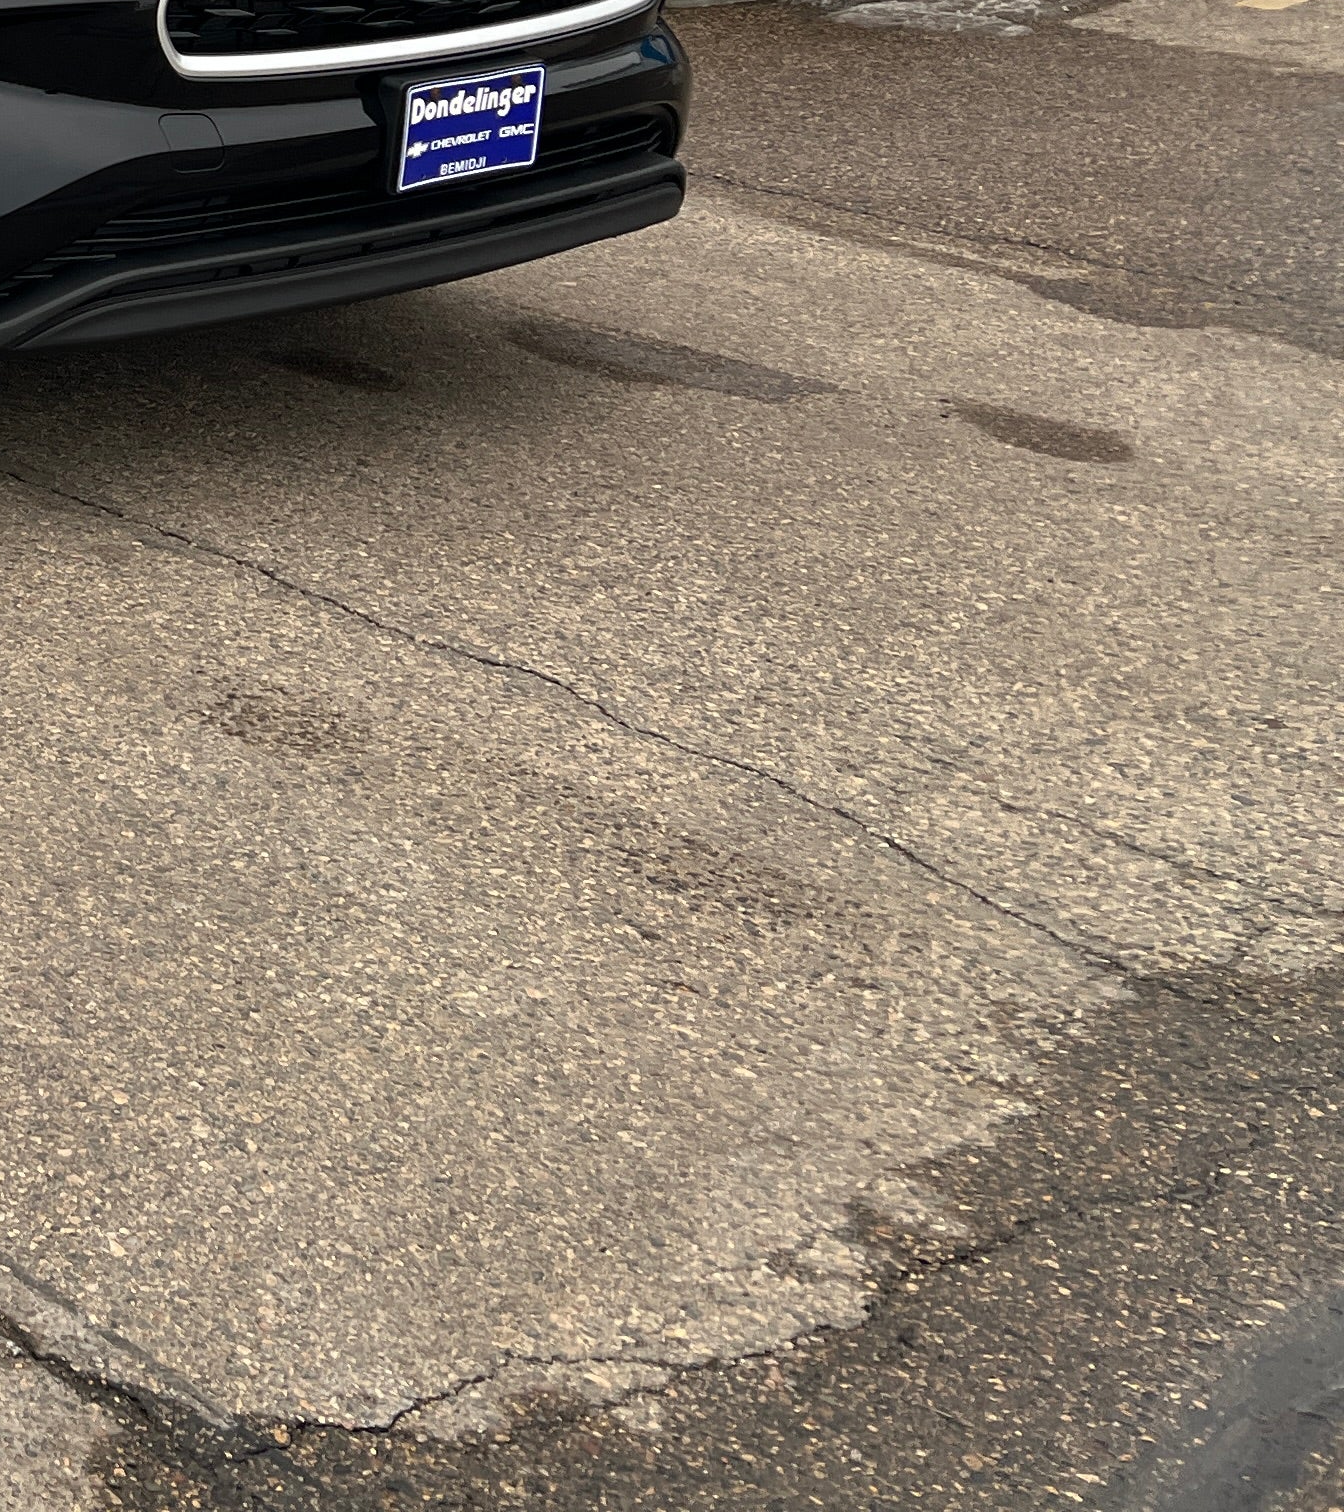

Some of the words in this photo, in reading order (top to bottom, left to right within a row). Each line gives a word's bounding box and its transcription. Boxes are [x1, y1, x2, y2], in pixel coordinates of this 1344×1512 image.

[411, 85, 536, 125] Dondelinger
[430, 129, 492, 151] CHEVROLET
[499, 123, 535, 138] GMC
[440, 156, 487, 176] BEMIDJI
